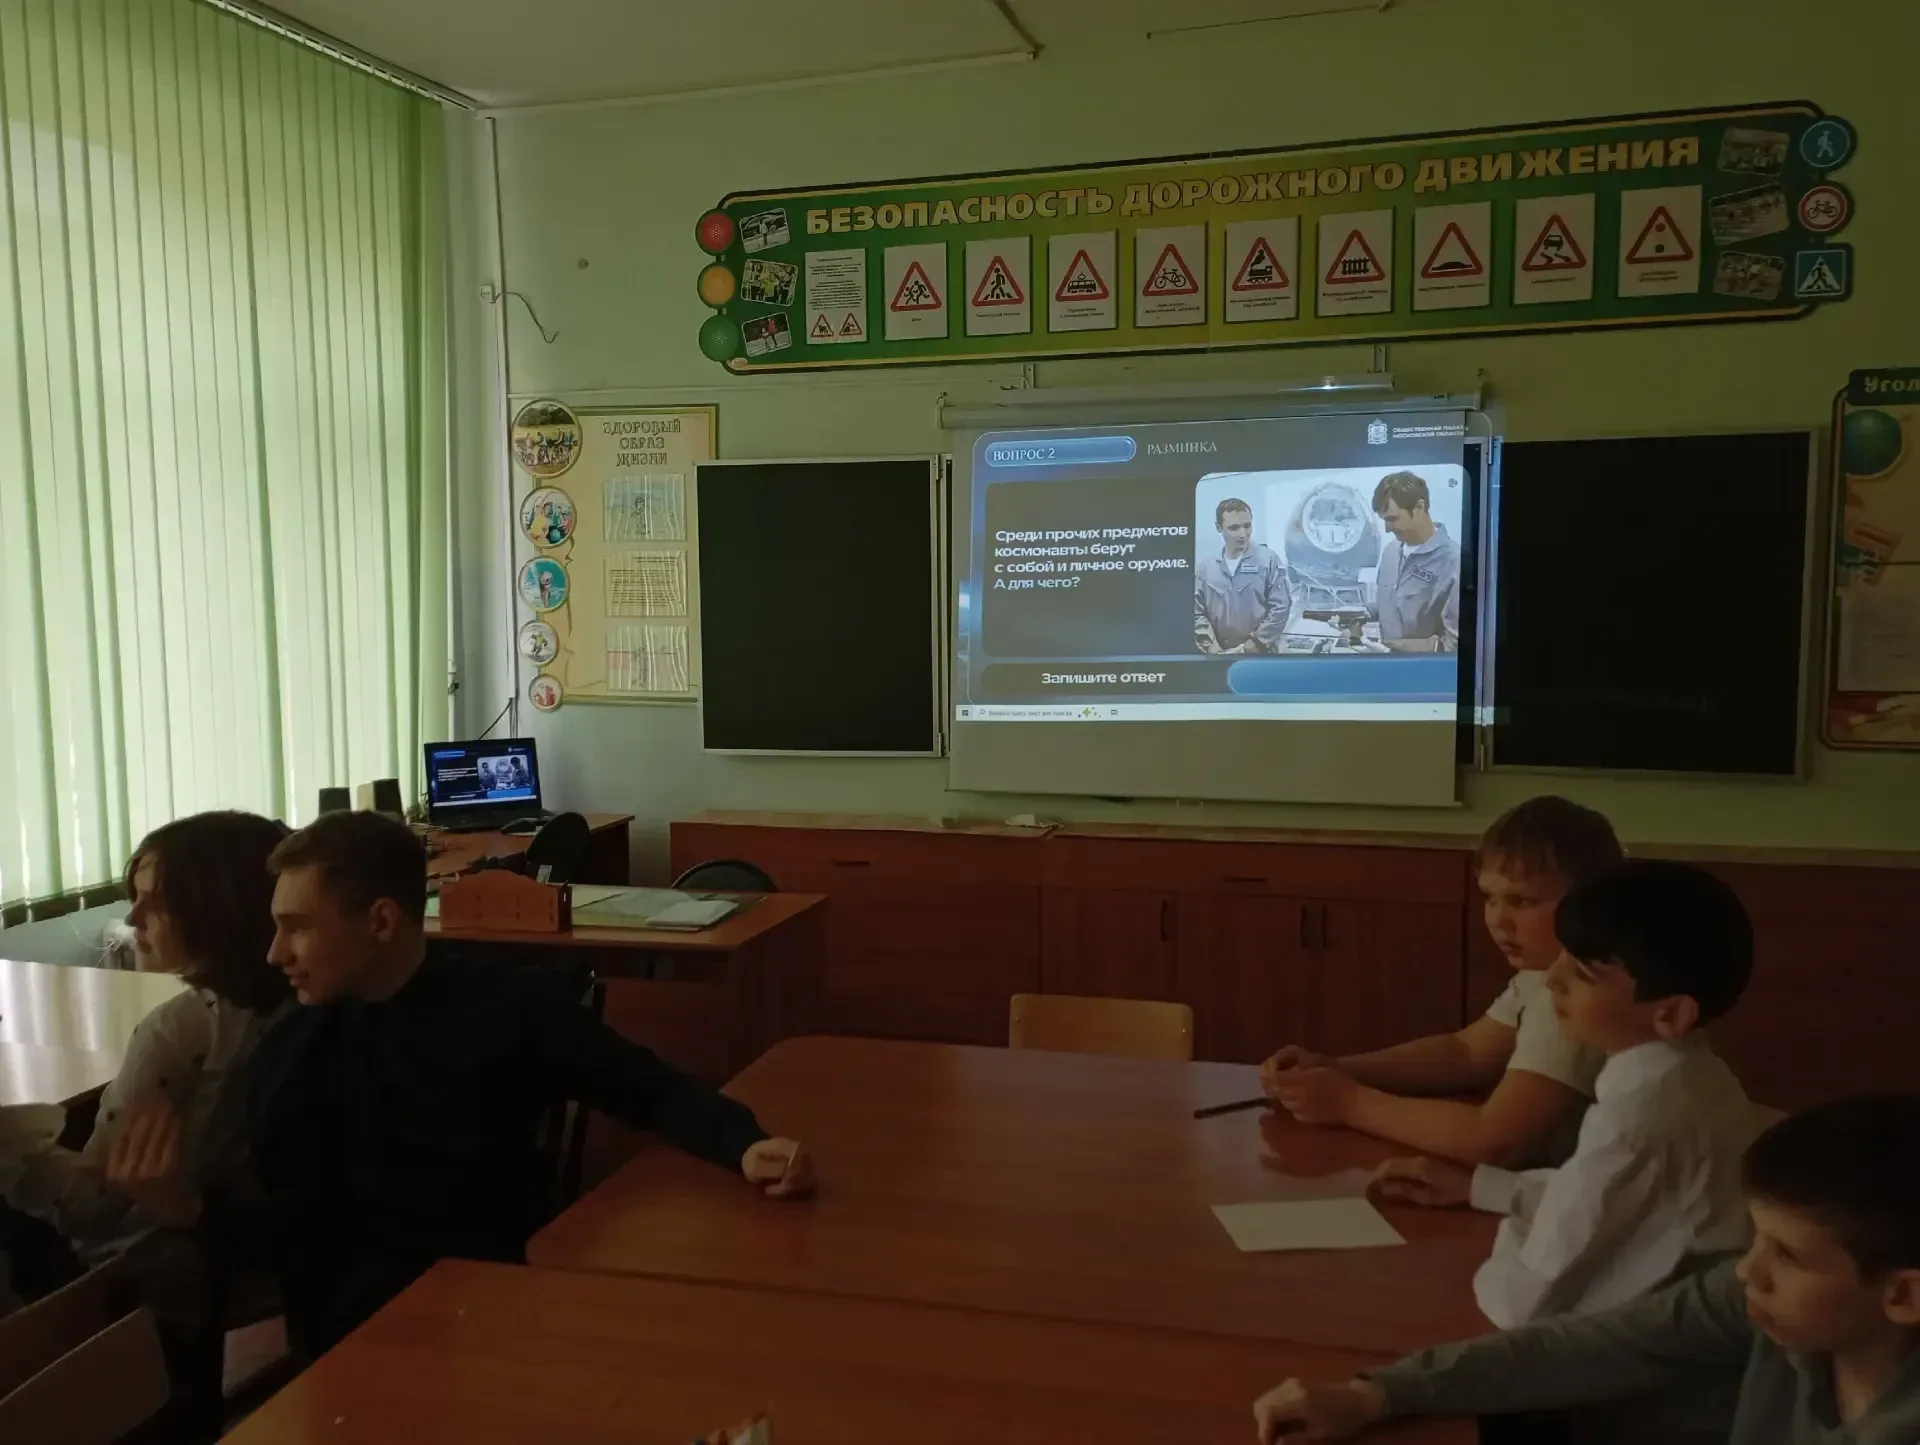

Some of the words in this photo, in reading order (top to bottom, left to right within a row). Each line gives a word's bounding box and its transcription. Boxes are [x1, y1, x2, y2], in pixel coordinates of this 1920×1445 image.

[807, 187, 1114, 235] БЕЗОПАСНОСТЬ
[1120, 161, 1406, 216] ДОРОЖНОГО
[1413, 136, 1700, 194] ДВИЖЕНИЯ
[603, 418, 680, 435] ЗДОРОВЫЙ
[620, 437, 665, 449] ОБРАЗ
[1147, 440, 1218, 455] РАЗМИНКА
[616, 452, 667, 466] ЖИЗНИ
[993, 449, 1045, 461] ВОПРОС
[1047, 448, 1055, 459] 2
[995, 530, 1042, 544] Среди
[1045, 528, 1100, 542] прочих
[1102, 526, 1188, 540] предметов
[994, 545, 1089, 558] космонавты
[1090, 543, 1136, 557] берут
[994, 564, 1003, 573] с
[1006, 560, 1055, 573] собой
[1057, 562, 1067, 572] и
[1069, 560, 1124, 572] личное
[1127, 558, 1189, 572] оружие.
[993, 578, 1006, 589] А
[1007, 578, 1034, 590] для
[1037, 576, 1081, 589] чего?
[1041, 672, 1117, 684] Запишите
[1119, 672, 1166, 683] ответ
